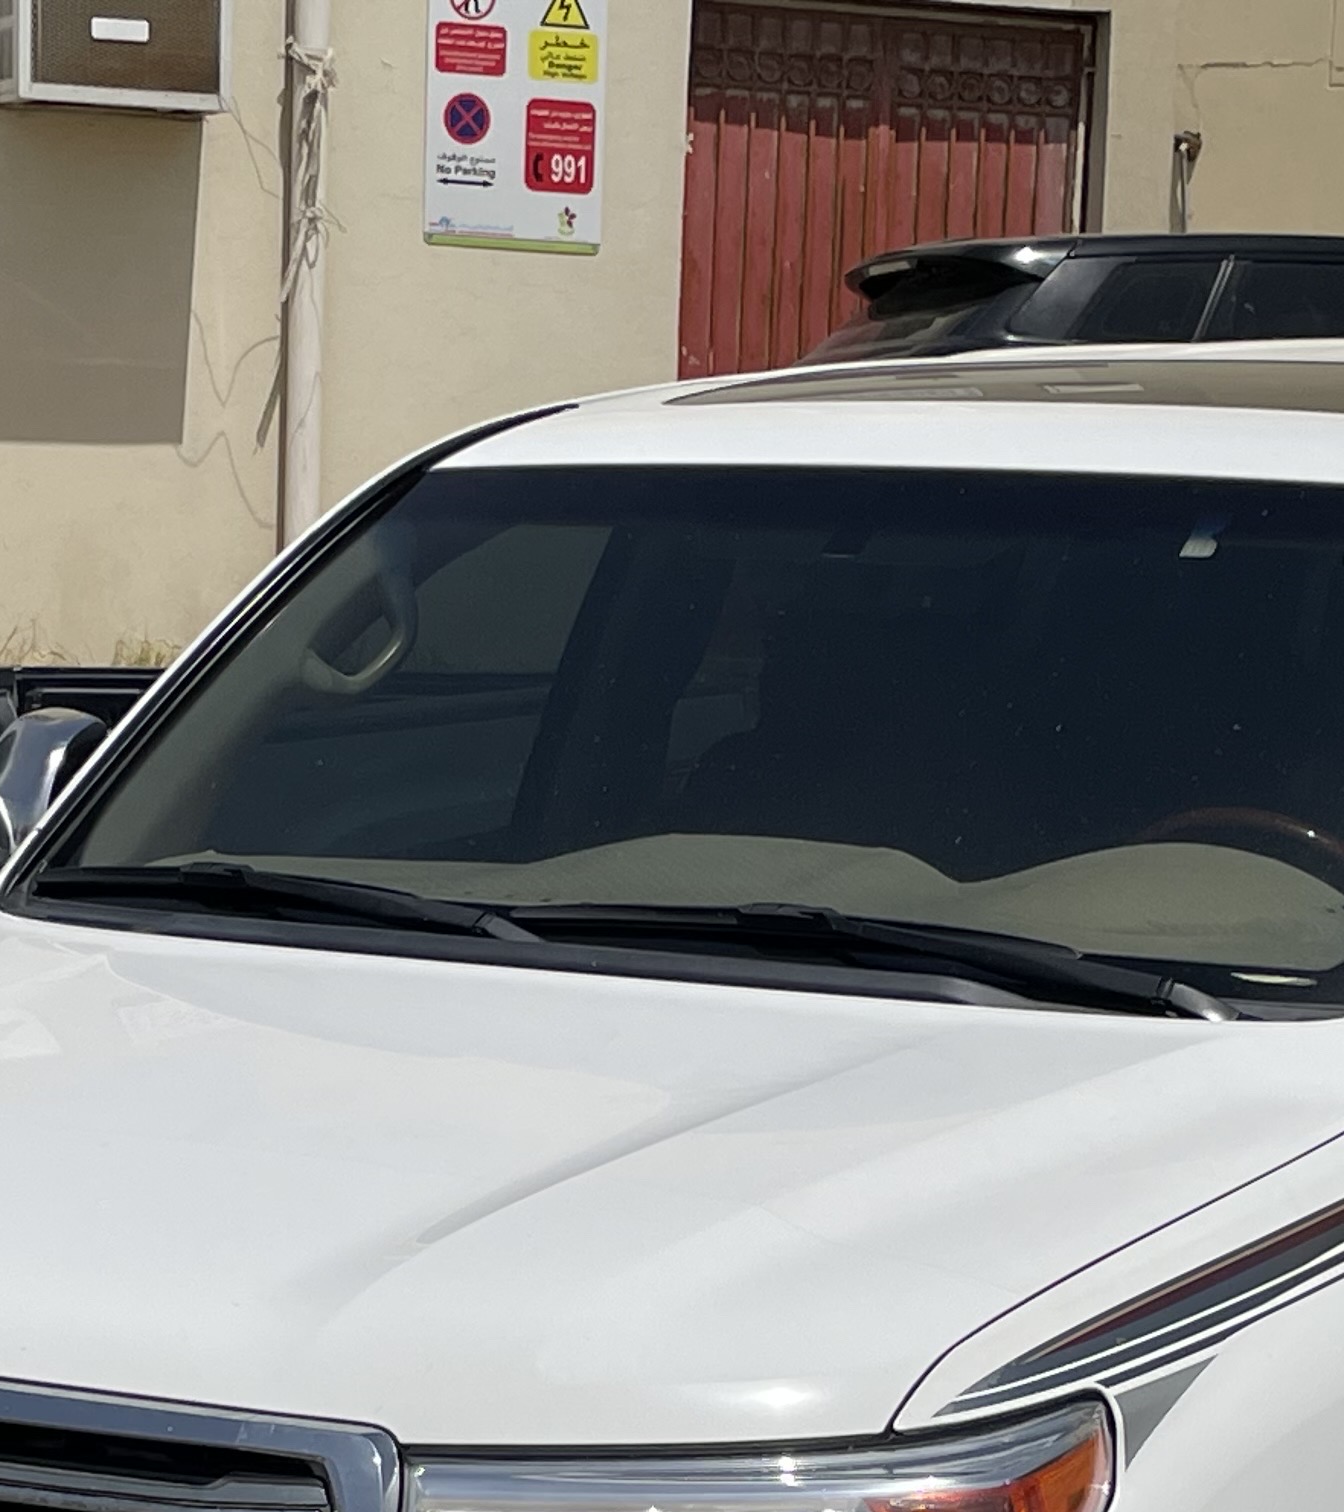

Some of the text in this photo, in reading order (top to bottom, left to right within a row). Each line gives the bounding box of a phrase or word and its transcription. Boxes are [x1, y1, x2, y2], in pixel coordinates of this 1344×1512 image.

[436, 163, 496, 180] No Parking
[550, 153, 587, 184] 991
